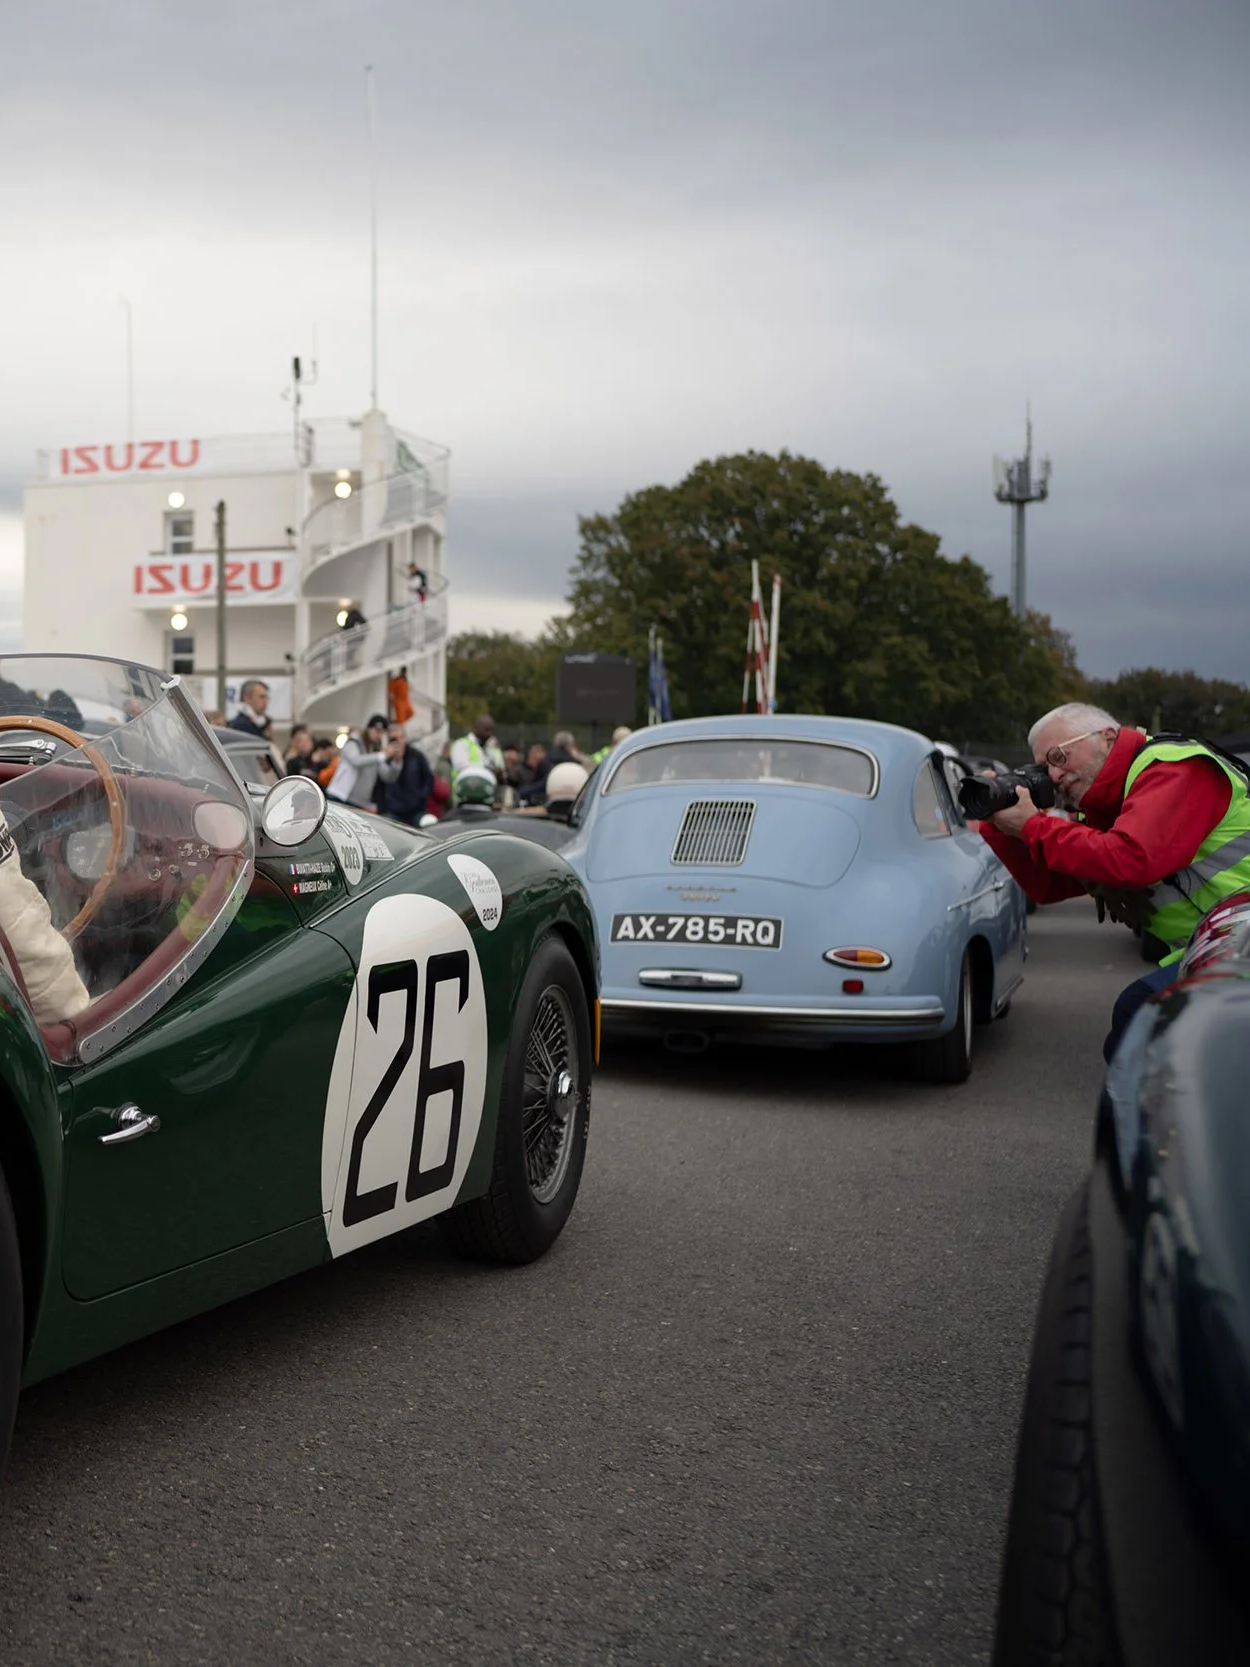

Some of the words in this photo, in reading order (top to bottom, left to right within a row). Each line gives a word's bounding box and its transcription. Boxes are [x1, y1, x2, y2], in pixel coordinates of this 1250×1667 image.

[60, 438, 201, 475] ISUZU
[133, 560, 283, 595] ISUZU
[341, 845, 360, 870] 2023
[482, 907, 498, 921] 2024
[616, 916, 776, 945] AX-785-RQ
[342, 949, 470, 1228] 26
